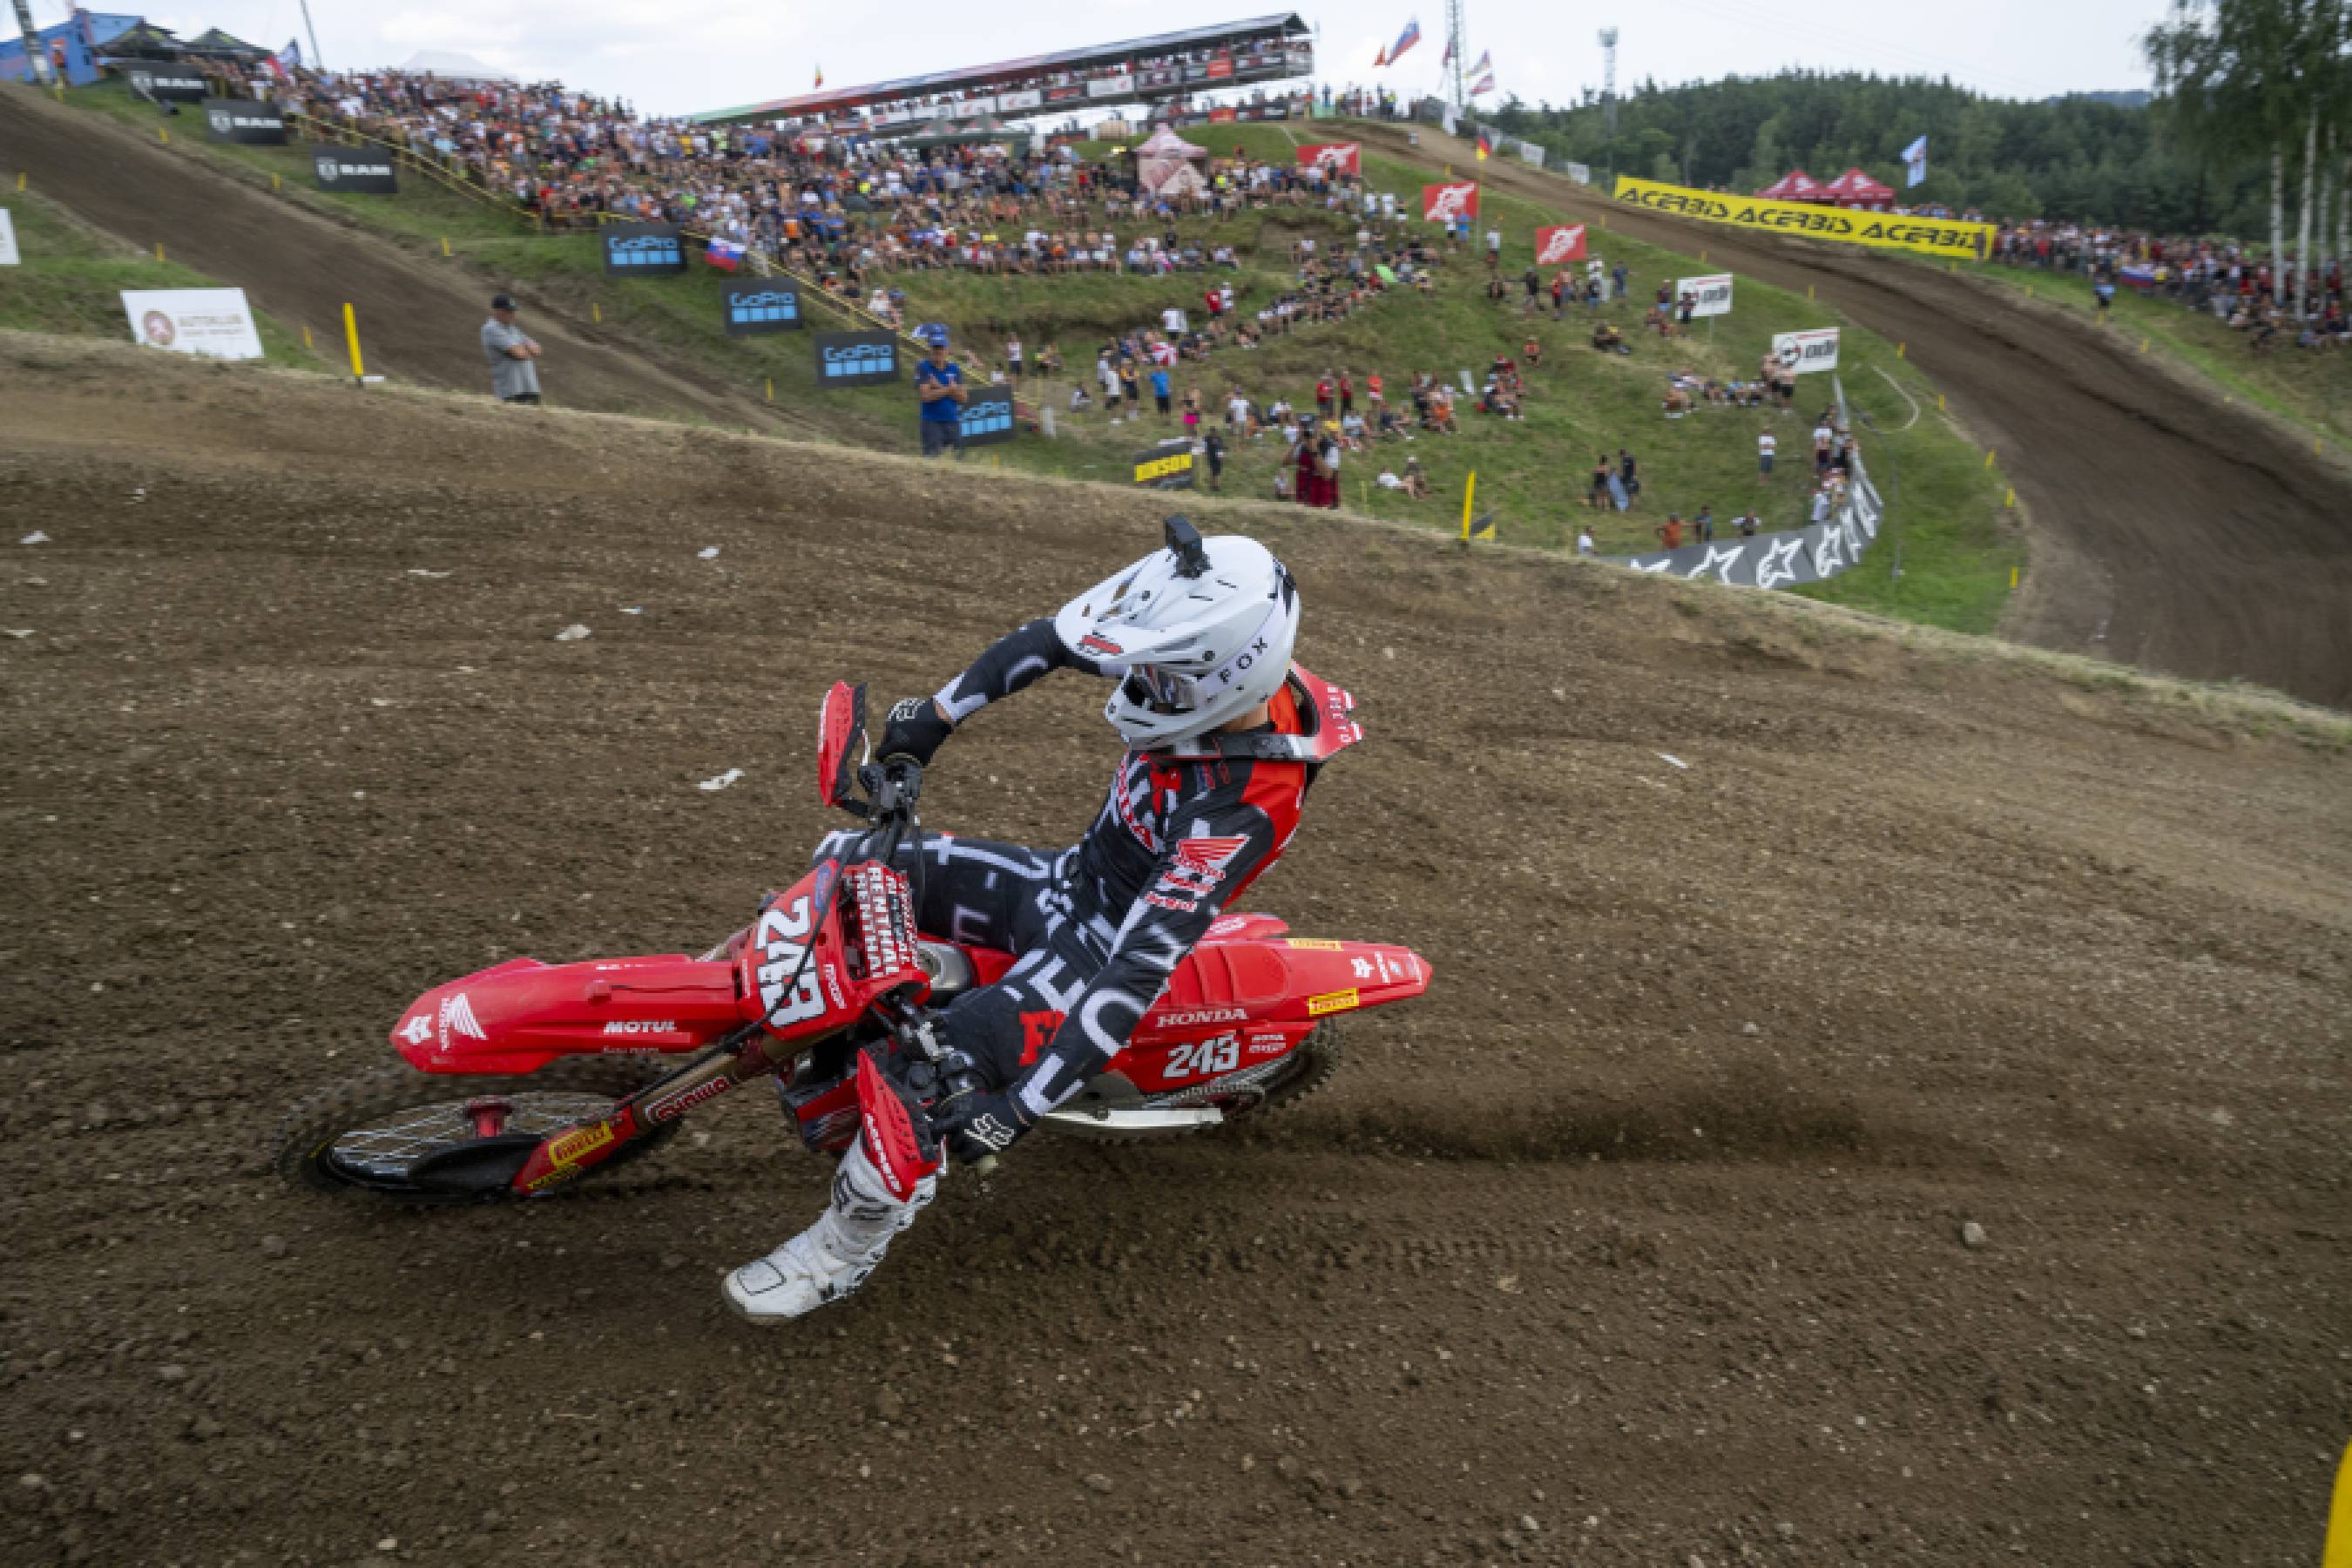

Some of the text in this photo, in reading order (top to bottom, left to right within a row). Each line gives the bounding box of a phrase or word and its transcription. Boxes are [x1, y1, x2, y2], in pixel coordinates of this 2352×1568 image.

[1618, 186, 1729, 219] ACERBIS
[1734, 206, 1854, 235] ACERBIS
[609, 235, 679, 251] GoPro
[730, 290, 796, 308] GoPro
[823, 343, 893, 362] GoPro
[1218, 636, 1268, 684] FOX
[603, 1018, 678, 1035] MOTUL
[1156, 1008, 1248, 1028] HONDA
[1162, 1033, 1240, 1078] 243
